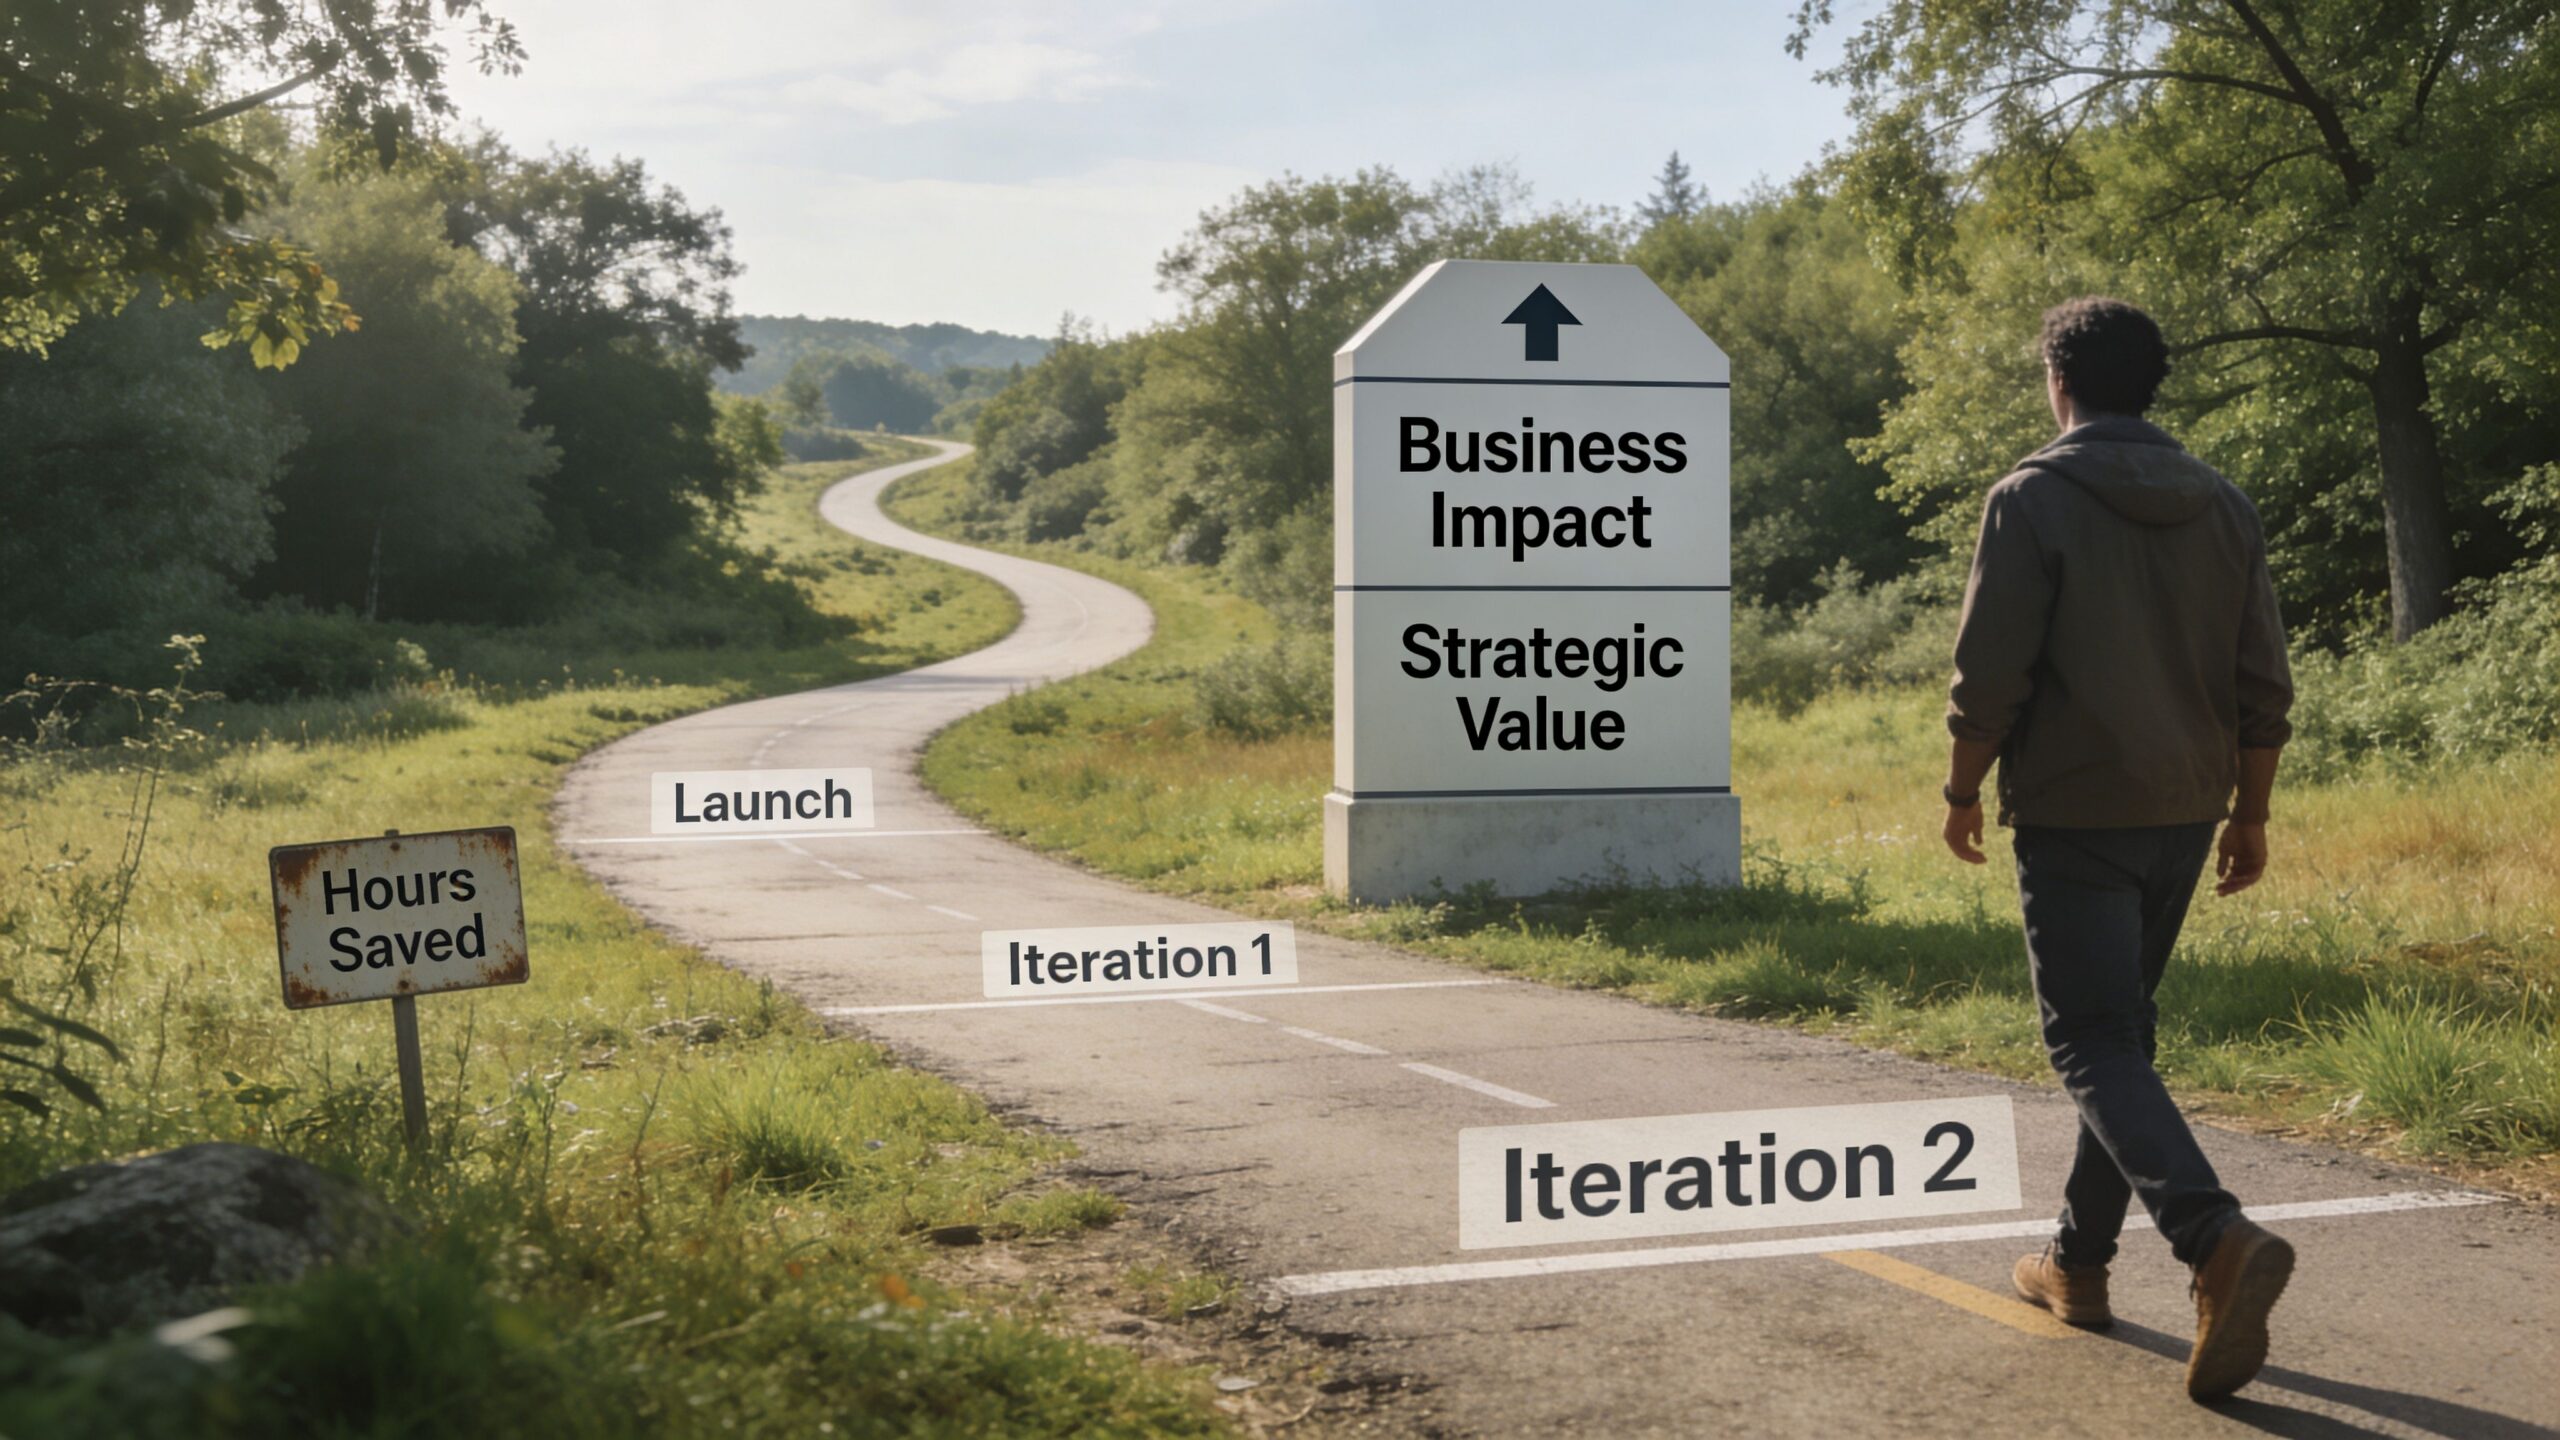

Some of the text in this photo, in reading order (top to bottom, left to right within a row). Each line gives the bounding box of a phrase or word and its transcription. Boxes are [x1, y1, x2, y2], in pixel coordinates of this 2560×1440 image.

[1399, 416, 1688, 474] Business
[1432, 491, 1653, 563] Impact
[1400, 622, 1684, 693] Strategic
[1456, 695, 1626, 752] Value
[322, 866, 477, 915] Hours
[328, 913, 486, 972] Saved
